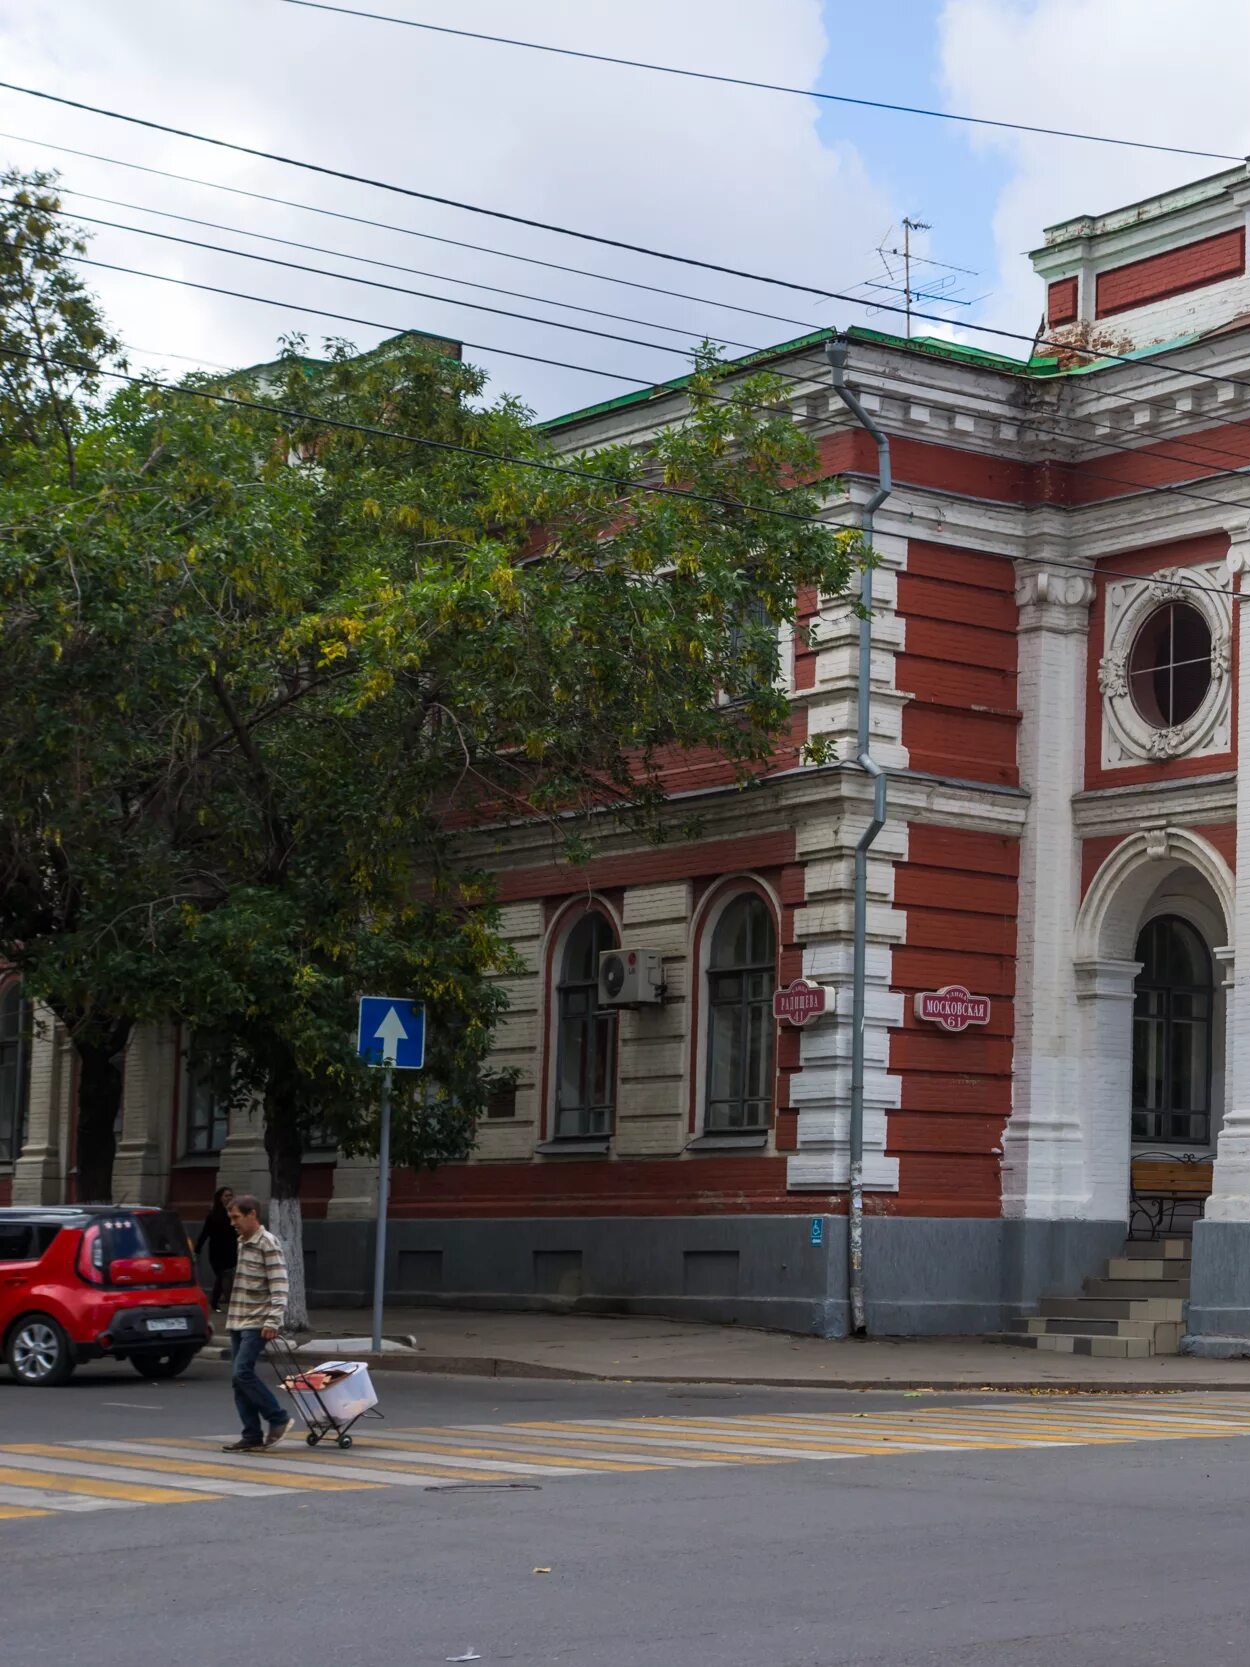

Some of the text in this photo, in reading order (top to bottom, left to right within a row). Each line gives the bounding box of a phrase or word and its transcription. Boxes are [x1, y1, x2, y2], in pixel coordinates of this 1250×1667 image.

[780, 994, 818, 1011] РАДИЩЕВА
[926, 999, 985, 1017] МОСКОВСКАЯ
[947, 1016, 962, 1028] 61
